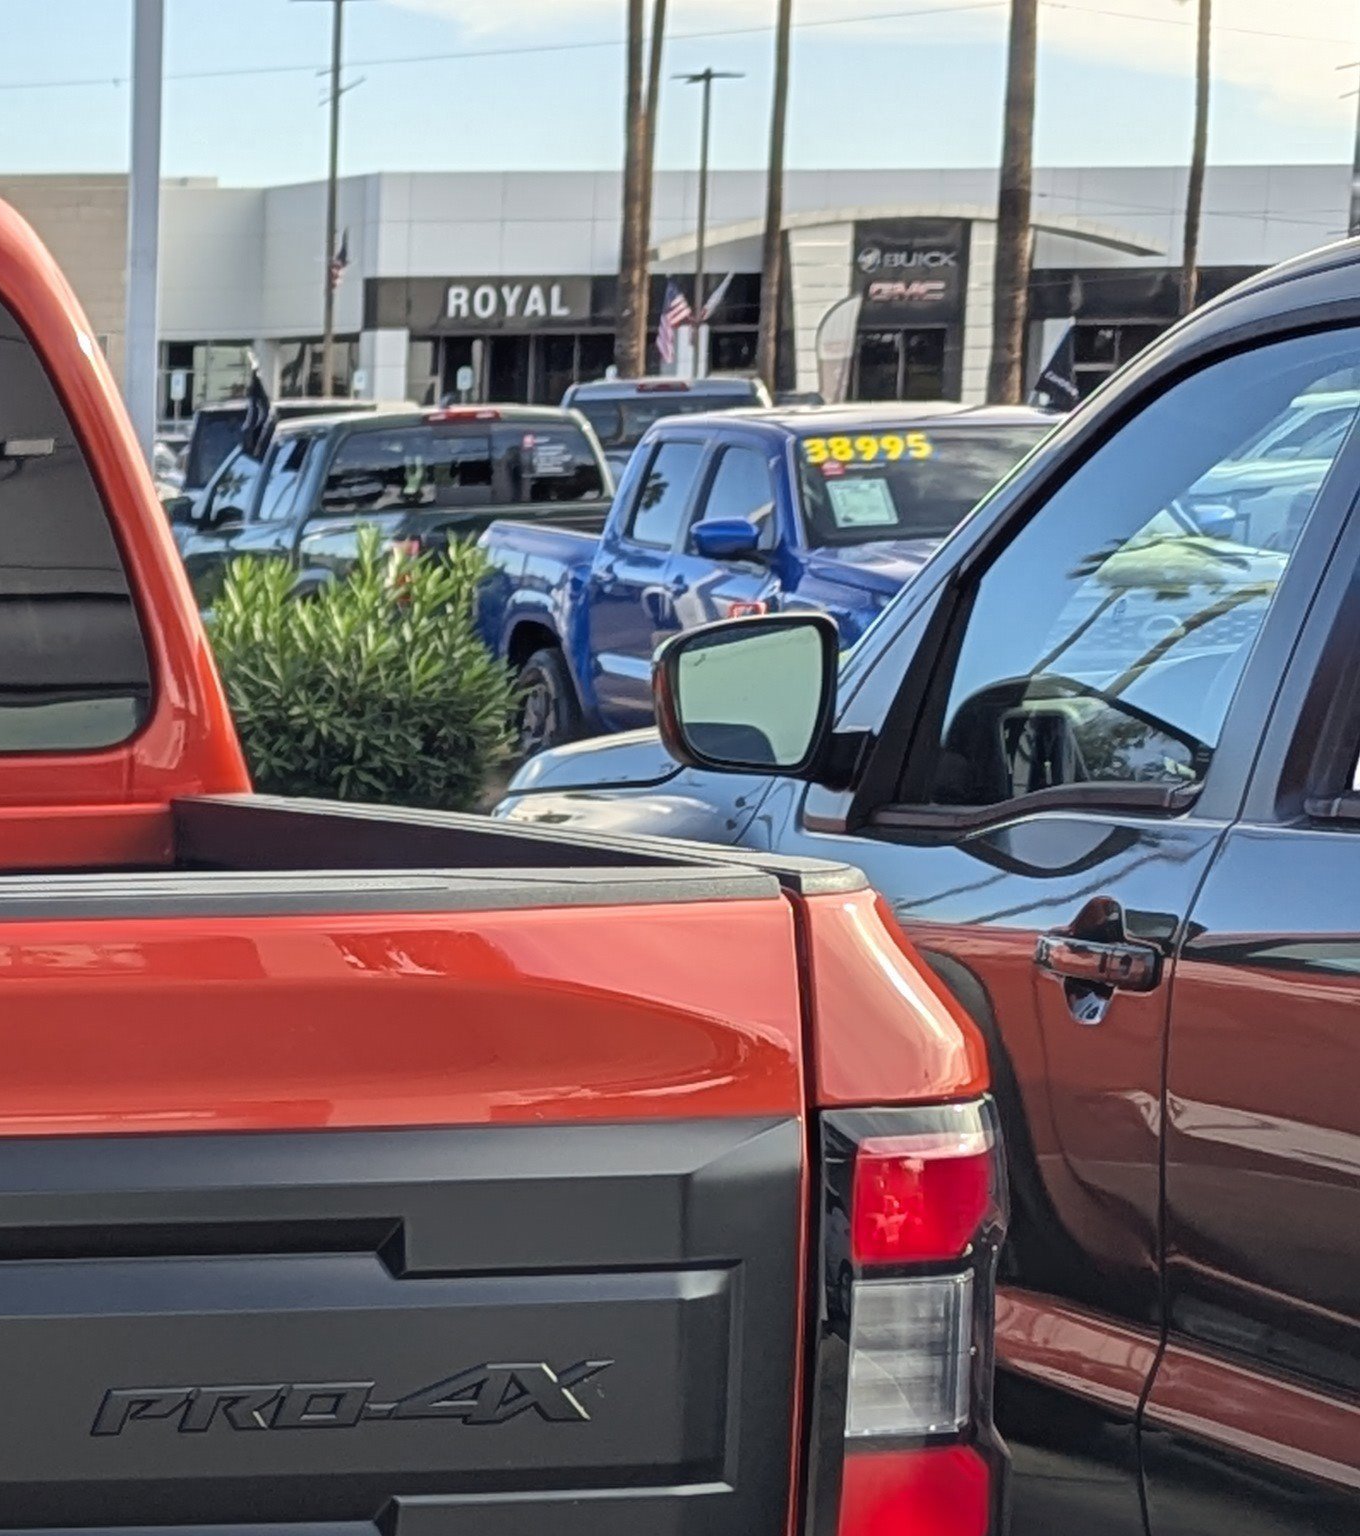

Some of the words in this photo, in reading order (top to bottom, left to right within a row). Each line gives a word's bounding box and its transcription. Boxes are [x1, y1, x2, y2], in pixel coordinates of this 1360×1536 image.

[883, 251, 958, 268] BUICK
[447, 284, 570, 318] ROYAL
[802, 431, 933, 463] 38995
[90, 1359, 616, 1436] PRO-4X
